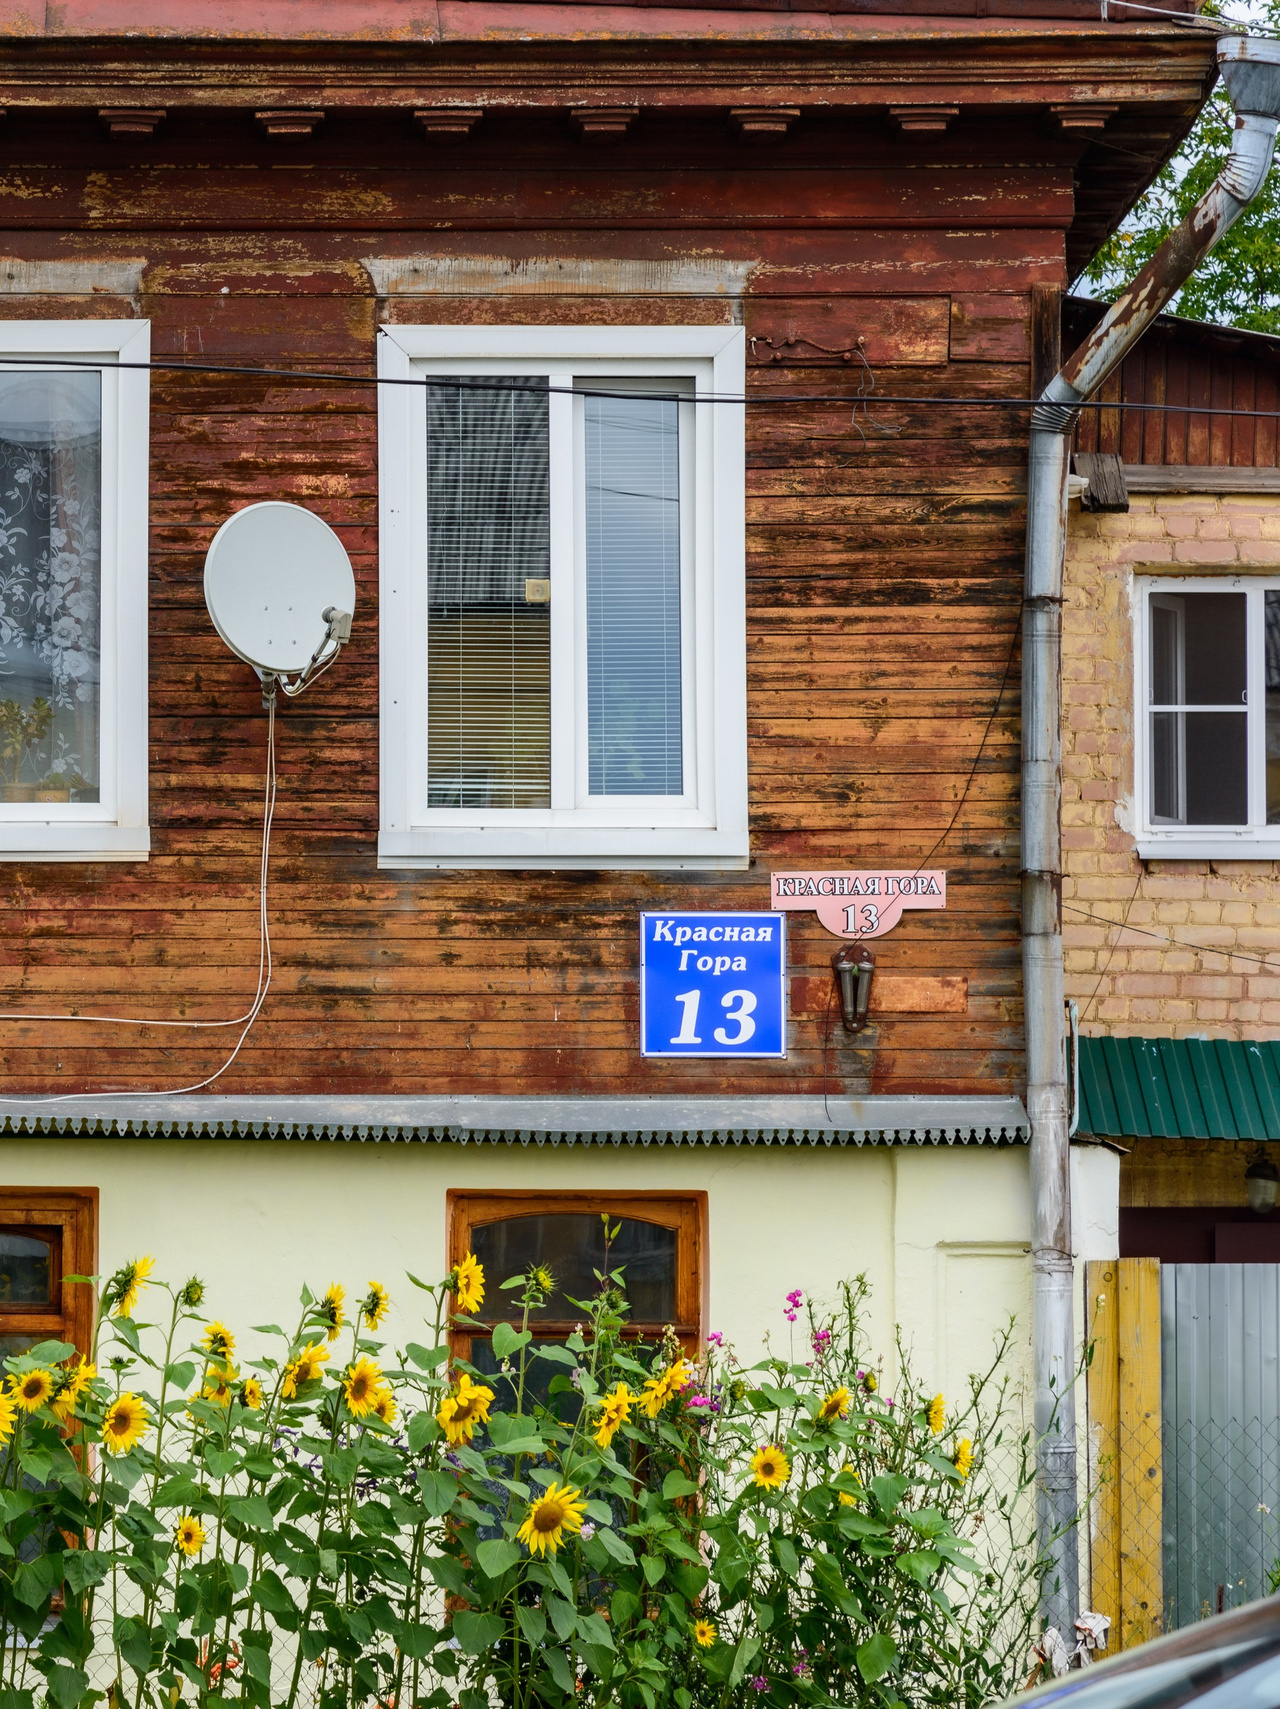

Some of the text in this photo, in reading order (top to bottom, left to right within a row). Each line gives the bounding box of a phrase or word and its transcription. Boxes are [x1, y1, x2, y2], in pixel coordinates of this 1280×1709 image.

[776, 877, 941, 896] КРАСНАЯ ГОРА
[842, 904, 880, 934] 13
[652, 920, 773, 946] Красная
[678, 950, 747, 975] Гора
[670, 989, 758, 1045] 13
